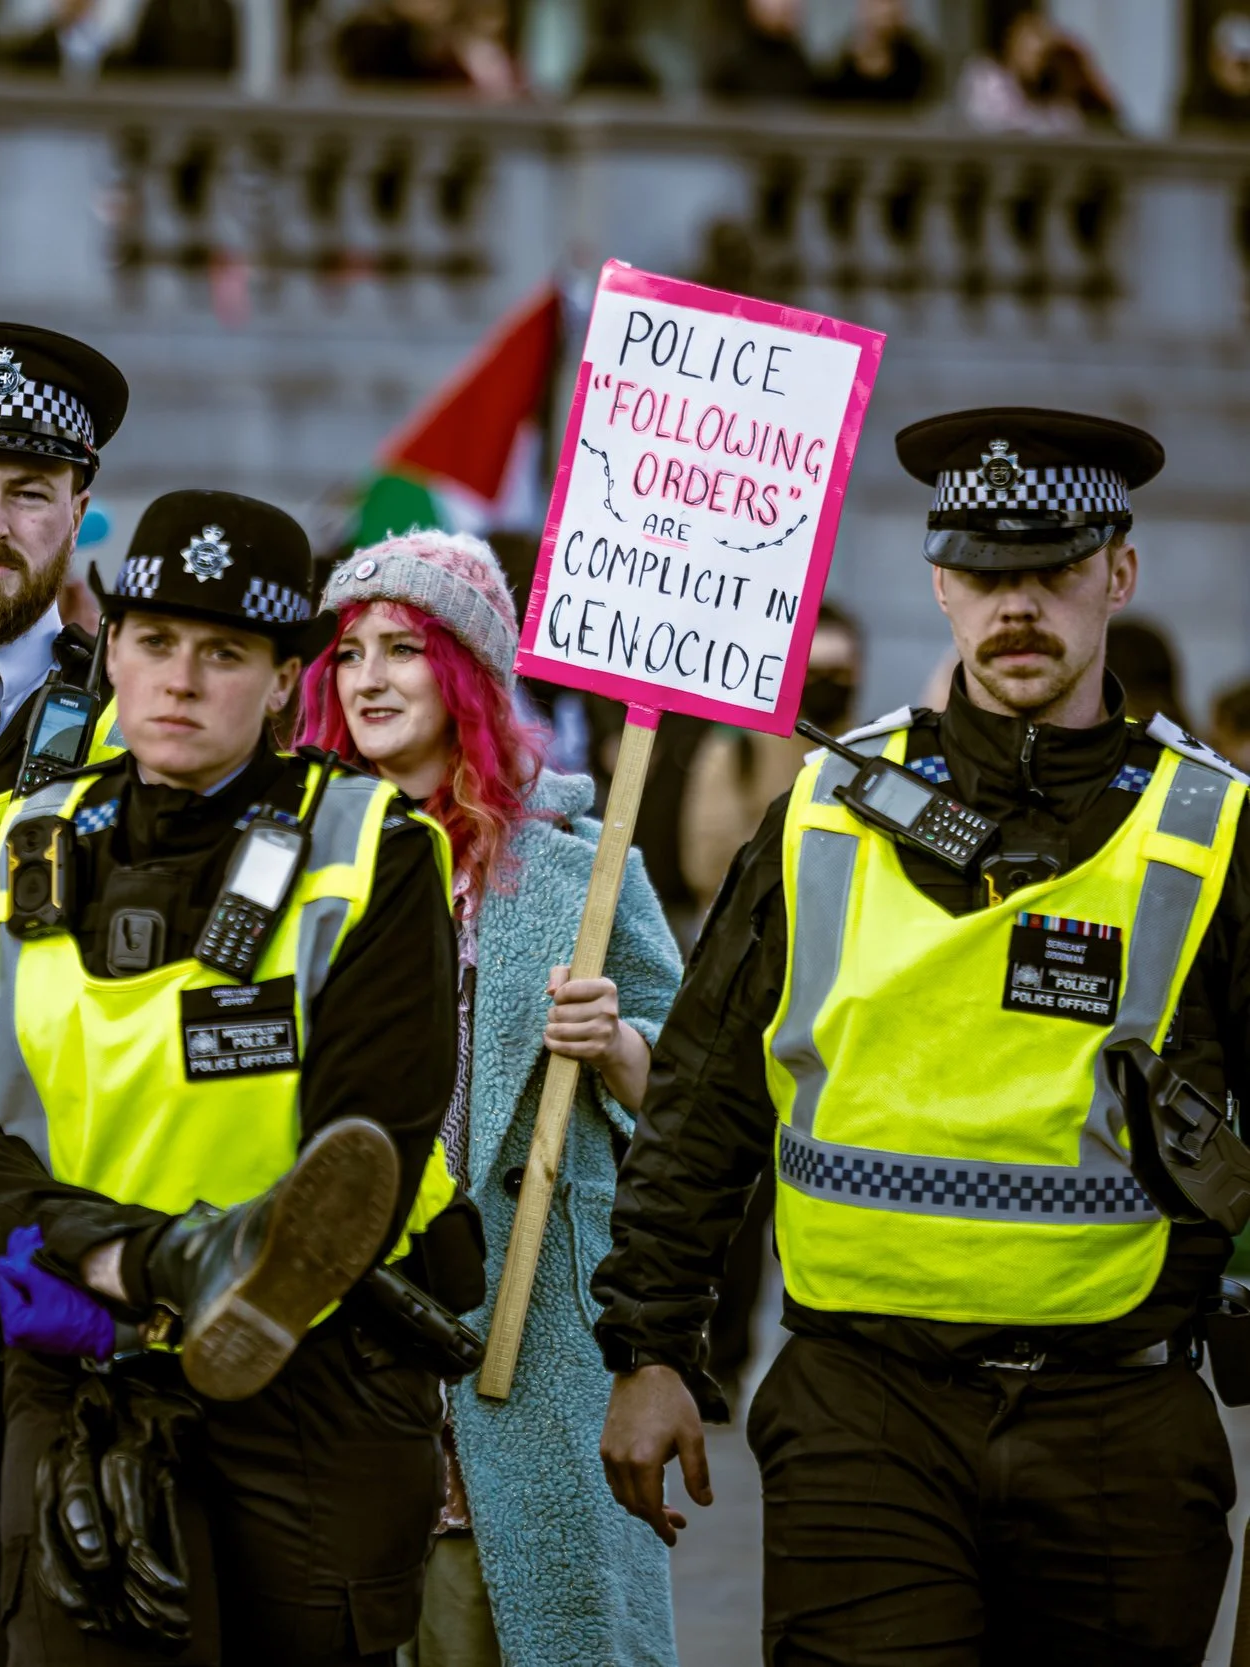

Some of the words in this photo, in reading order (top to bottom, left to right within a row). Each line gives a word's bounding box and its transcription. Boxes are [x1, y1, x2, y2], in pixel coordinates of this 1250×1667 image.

[619, 310, 793, 396] POLICE
[593, 373, 826, 483] "FOLLOWING
[633, 452, 803, 527] ORDERS"
[641, 513, 692, 543] ARE
[564, 530, 750, 611] COMPLICIT
[765, 588, 799, 625] IN
[548, 593, 784, 704] GENOCIDE
[1010, 989, 1055, 1007] POLICE
[1057, 997, 1110, 1016] OFFICER
[1055, 978, 1098, 994] POLICE
[190, 1056, 238, 1073] POLICE
[239, 1051, 295, 1069] OFFICER
[232, 1035, 278, 1050] POLICE
